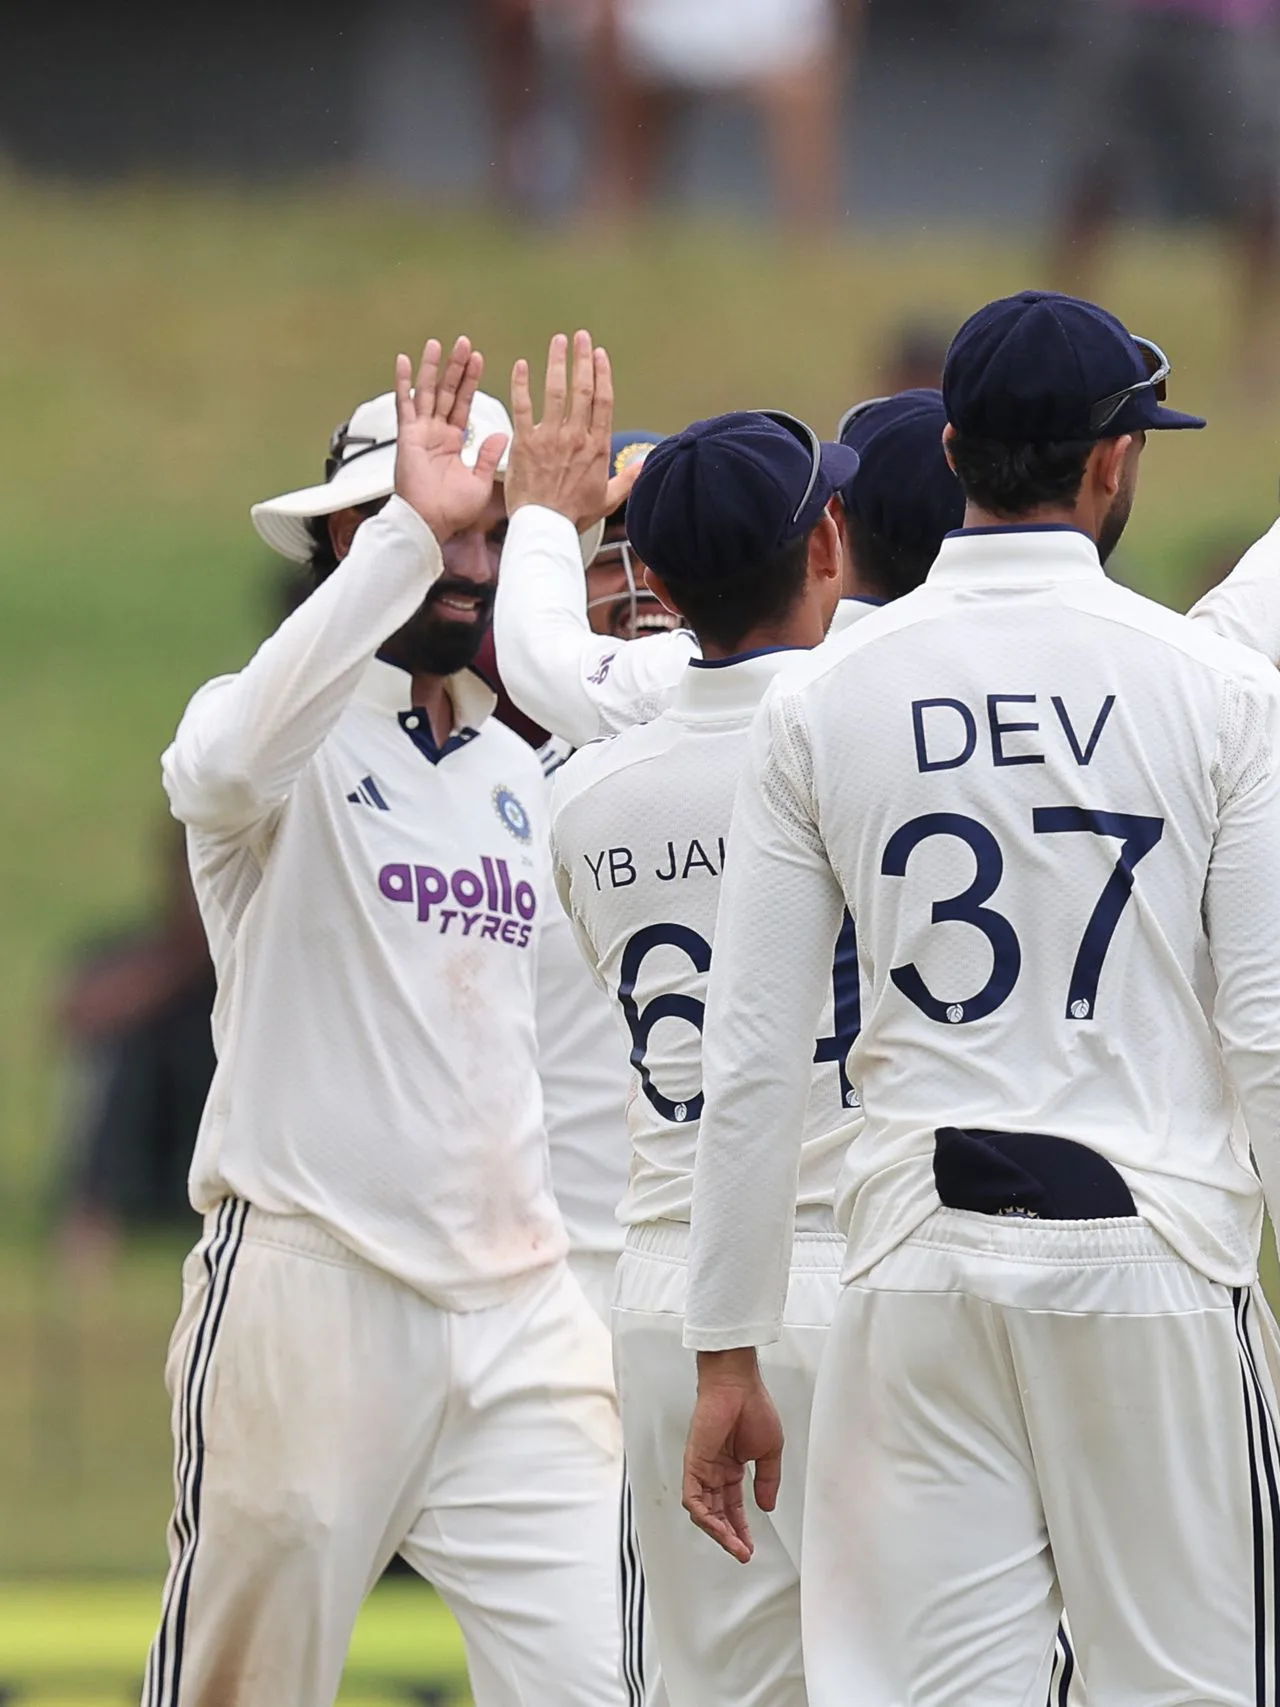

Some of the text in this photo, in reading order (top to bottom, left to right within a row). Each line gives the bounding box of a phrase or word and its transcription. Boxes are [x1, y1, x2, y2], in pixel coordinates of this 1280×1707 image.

[911, 694, 1117, 773] DEV
[378, 855, 536, 922] apollo
[583, 847, 637, 891] YB
[440, 909, 533, 948] TYRES
[881, 806, 1165, 1024] 37
